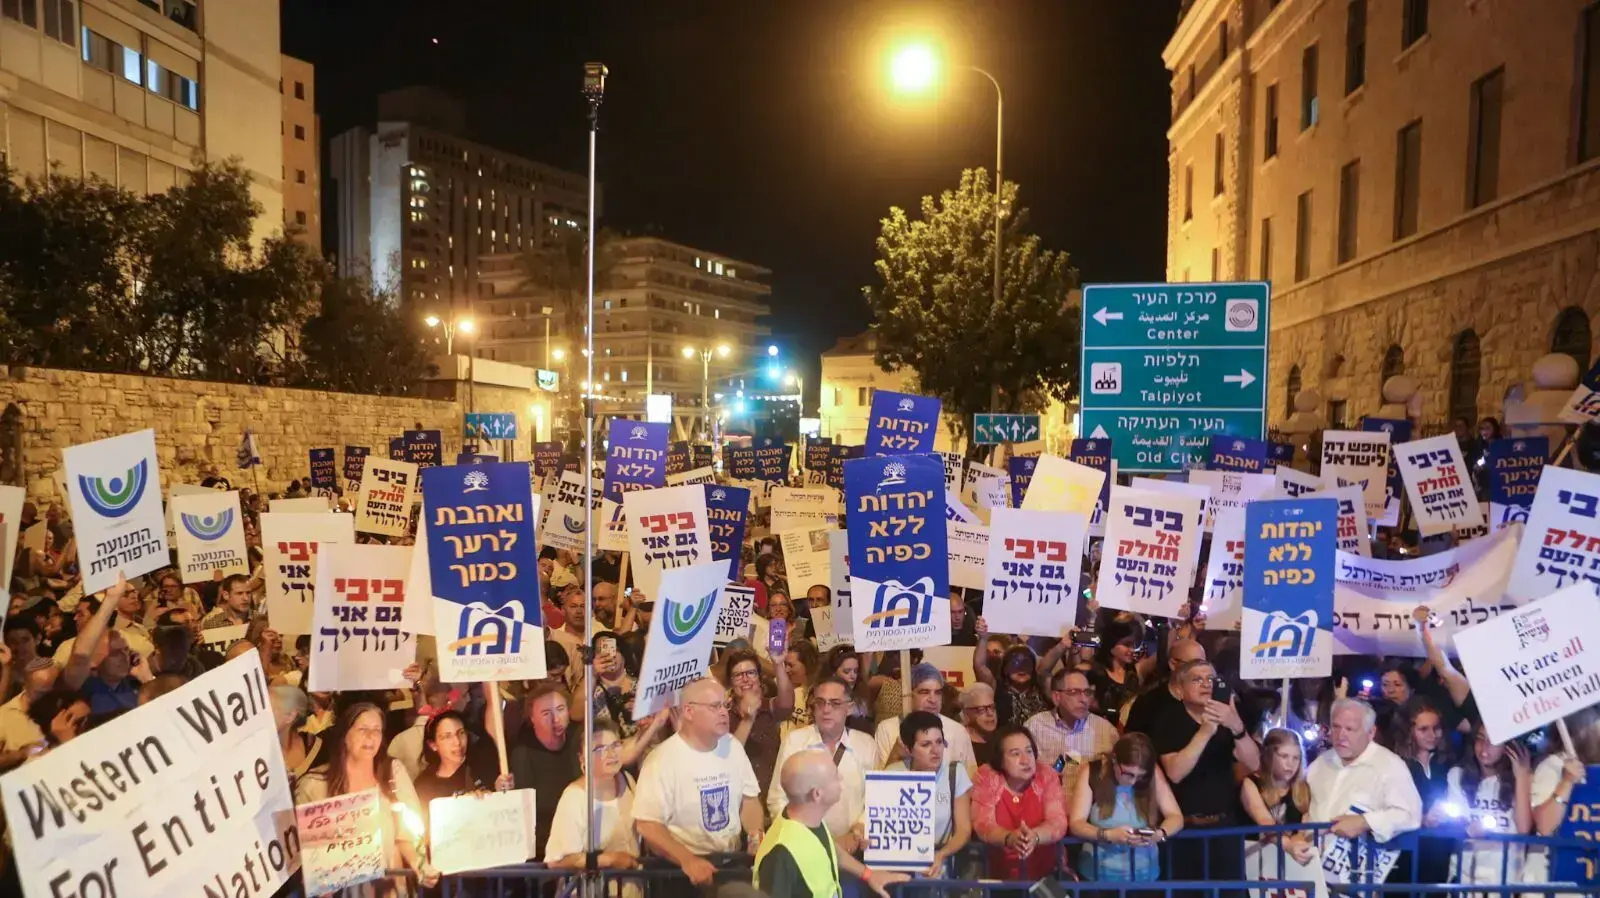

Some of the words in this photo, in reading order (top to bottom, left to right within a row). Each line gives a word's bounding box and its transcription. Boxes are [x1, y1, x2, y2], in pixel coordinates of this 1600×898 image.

[1132, 292, 1168, 306] העיר
[1177, 291, 1217, 305] מרכז
[1138, 311, 1178, 324] المدينة
[1184, 312, 1210, 325] مركز
[1147, 328, 1199, 340] Center
[1143, 351, 1200, 367] תלפיות
[1140, 390, 1202, 404] Talpiyot
[876, 414, 929, 434] יהדות
[1118, 416, 1180, 432] העתיקה
[1188, 417, 1225, 431] העיר
[408, 442, 437, 451] יהדות
[880, 434, 920, 451] ללא
[1132, 435, 1173, 448] القديمة
[1179, 435, 1209, 447] البلدة
[1324, 441, 1345, 452] דת
[1348, 441, 1387, 454] חופש
[412, 452, 434, 460] ללא
[611, 445, 664, 461] יהדות
[733, 450, 754, 458] הדות
[1137, 451, 1162, 464] Old
[1171, 451, 1203, 466] City
[1213, 453, 1260, 470] ואהבת
[1323, 451, 1386, 467] לישראל
[1407, 448, 1454, 469] ביבי
[1495, 455, 1544, 469] ואהבת
[372, 467, 408, 486] ביבי
[616, 463, 656, 479] ללא
[1437, 465, 1457, 477] אל
[1499, 469, 1540, 484] לרעך
[391, 483, 406, 494] אל
[1416, 475, 1461, 496] תחלק
[1447, 488, 1465, 499] את
[368, 489, 405, 504] תחלק
[858, 489, 934, 513] יהדות
[1421, 492, 1446, 505] העם
[367, 500, 387, 511] העם
[388, 503, 404, 513] את
[1425, 499, 1469, 521] יהודי
[434, 503, 524, 527] ואהבת
[639, 511, 697, 534] ביבי
[707, 507, 742, 522] ואהב
[1123, 504, 1184, 533] ביבי
[869, 515, 925, 538] ללא
[1260, 520, 1323, 540] יהדות
[97, 527, 151, 557] התנועה
[443, 529, 519, 559] לרעך
[642, 534, 670, 549] אני
[675, 532, 699, 547] גם
[1155, 529, 1182, 546] אל
[91, 539, 162, 576] הרפורמית
[192, 549, 236, 563] התנועה
[865, 542, 932, 565] כפיה
[1004, 537, 1068, 562] ביבי
[1118, 539, 1180, 563] תחלק
[1268, 543, 1312, 562] ללא
[1539, 546, 1585, 567] העם
[187, 556, 243, 573] הרפורמית
[644, 548, 700, 570] יהודי
[1115, 557, 1150, 574] העם
[449, 561, 518, 588] כמוך
[1001, 561, 1035, 578] אני
[1040, 564, 1065, 580] גם
[1152, 562, 1178, 577] את
[1263, 568, 1317, 586] כפיה
[1341, 558, 1396, 583] הכותל
[333, 577, 405, 603] ביבי
[990, 578, 1072, 605] יהודיה
[1114, 571, 1175, 601] יהודי
[729, 593, 752, 610] לא
[331, 605, 369, 623] אני
[375, 606, 403, 623] גם
[1450, 596, 1518, 627] ולנו
[318, 625, 411, 653] יהודיה
[714, 624, 735, 637] חינ
[1500, 660, 1530, 683] We
[1533, 649, 1560, 672] are
[1562, 635, 1585, 659] all
[653, 658, 698, 682] התנועה
[1515, 663, 1584, 699] Women
[1511, 702, 1531, 725] of
[1533, 693, 1561, 716] the
[1562, 671, 1600, 702] Wall
[18, 733, 173, 841] Western
[176, 667, 267, 744] Wall
[899, 781, 932, 807] לא
[868, 806, 932, 821] מאמינים
[49, 857, 119, 898] For
[131, 756, 270, 878] Entire
[867, 818, 932, 836] בשנאת
[867, 835, 913, 851] חינם
[202, 823, 301, 898] Nation
